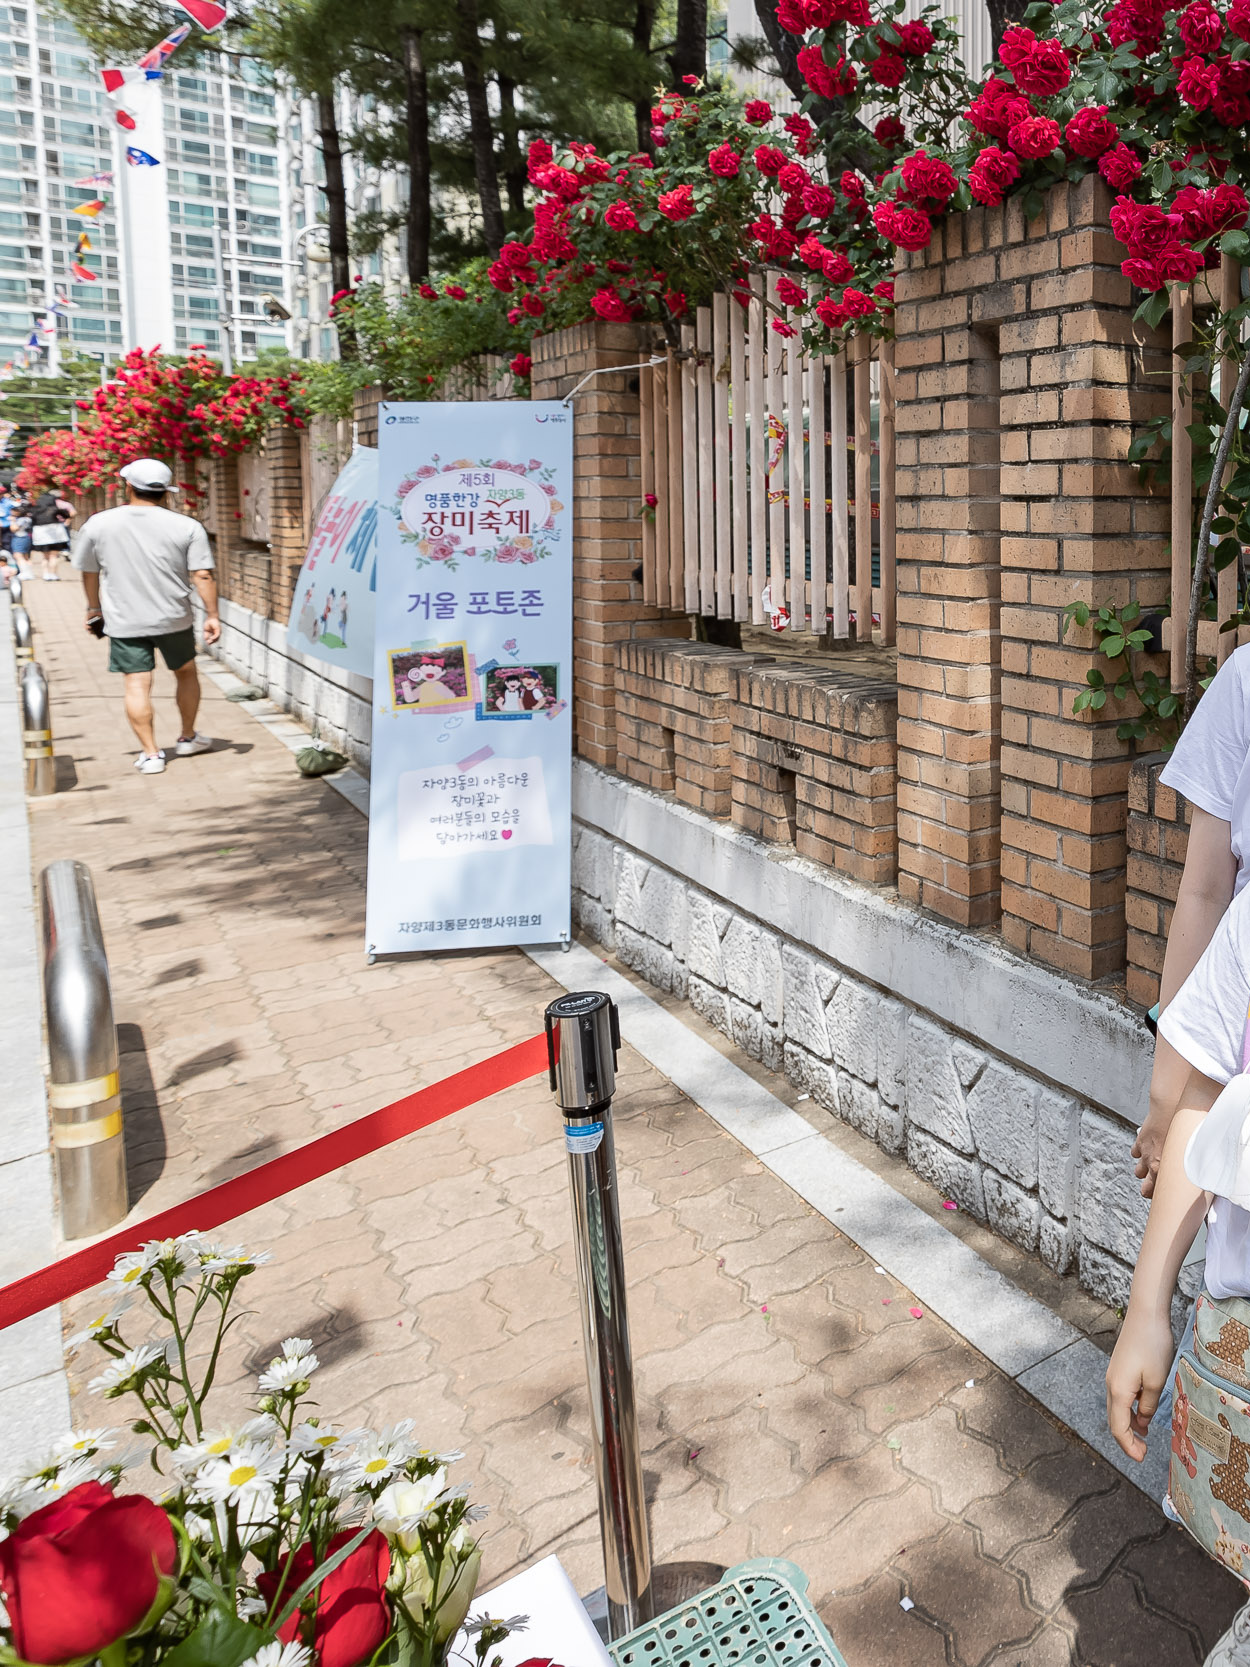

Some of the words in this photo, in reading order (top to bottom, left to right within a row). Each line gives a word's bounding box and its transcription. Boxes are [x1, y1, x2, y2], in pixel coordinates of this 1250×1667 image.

[458, 472, 495, 487] 제5회
[425, 492, 480, 508] 명품한강
[486, 488, 527, 501] 자양3동
[421, 509, 530, 537] 장미축제
[407, 591, 459, 620] 거울
[466, 589, 544, 617] 포토존
[422, 774, 479, 791] 자양3동의
[483, 772, 529, 788] 아름다운
[451, 791, 501, 807] 장미꽃과
[430, 810, 486, 827] 여러분들의
[491, 808, 520, 824] 모습을
[436, 829, 498, 845] 담아가세요
[398, 914, 542, 934] 자양제3동문화행사위원회
